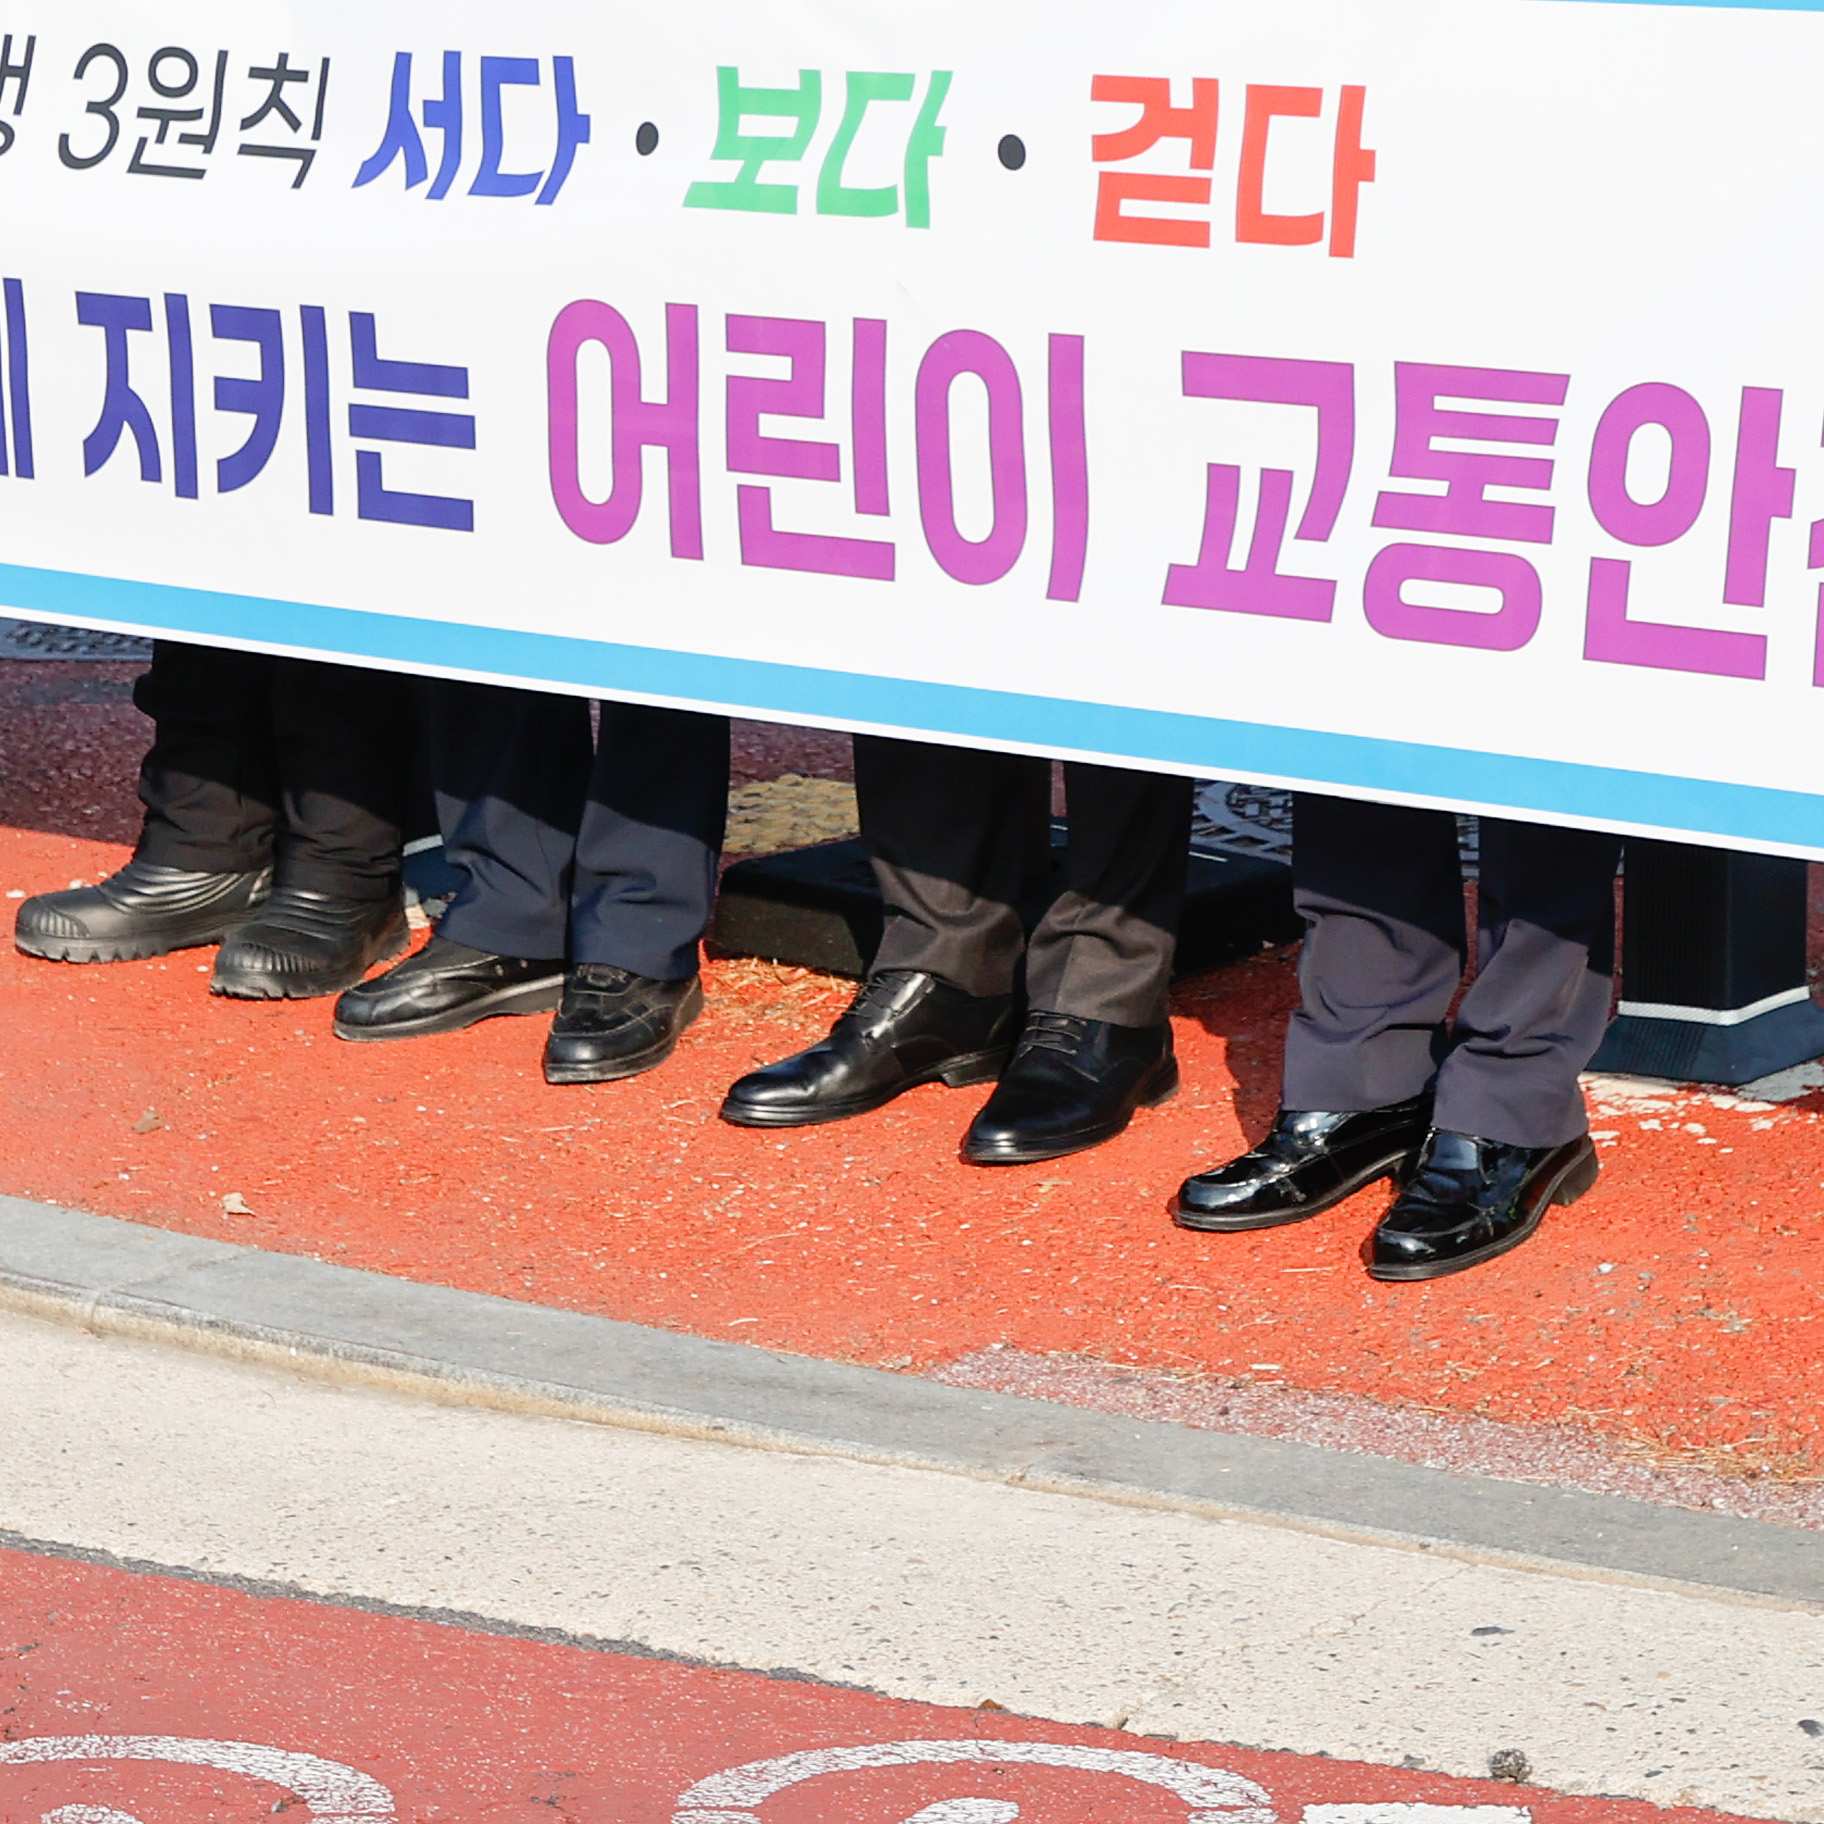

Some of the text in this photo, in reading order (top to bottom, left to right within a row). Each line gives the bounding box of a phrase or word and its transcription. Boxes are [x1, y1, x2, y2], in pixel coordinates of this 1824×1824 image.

[59, 44, 329, 188] 3원칙
[353, 51, 590, 205] 서다
[685, 66, 952, 228] 보다
[1091, 75, 1376, 258] 걷다
[76, 292, 475, 531] 지키는
[548, 300, 1088, 601] 어린이
